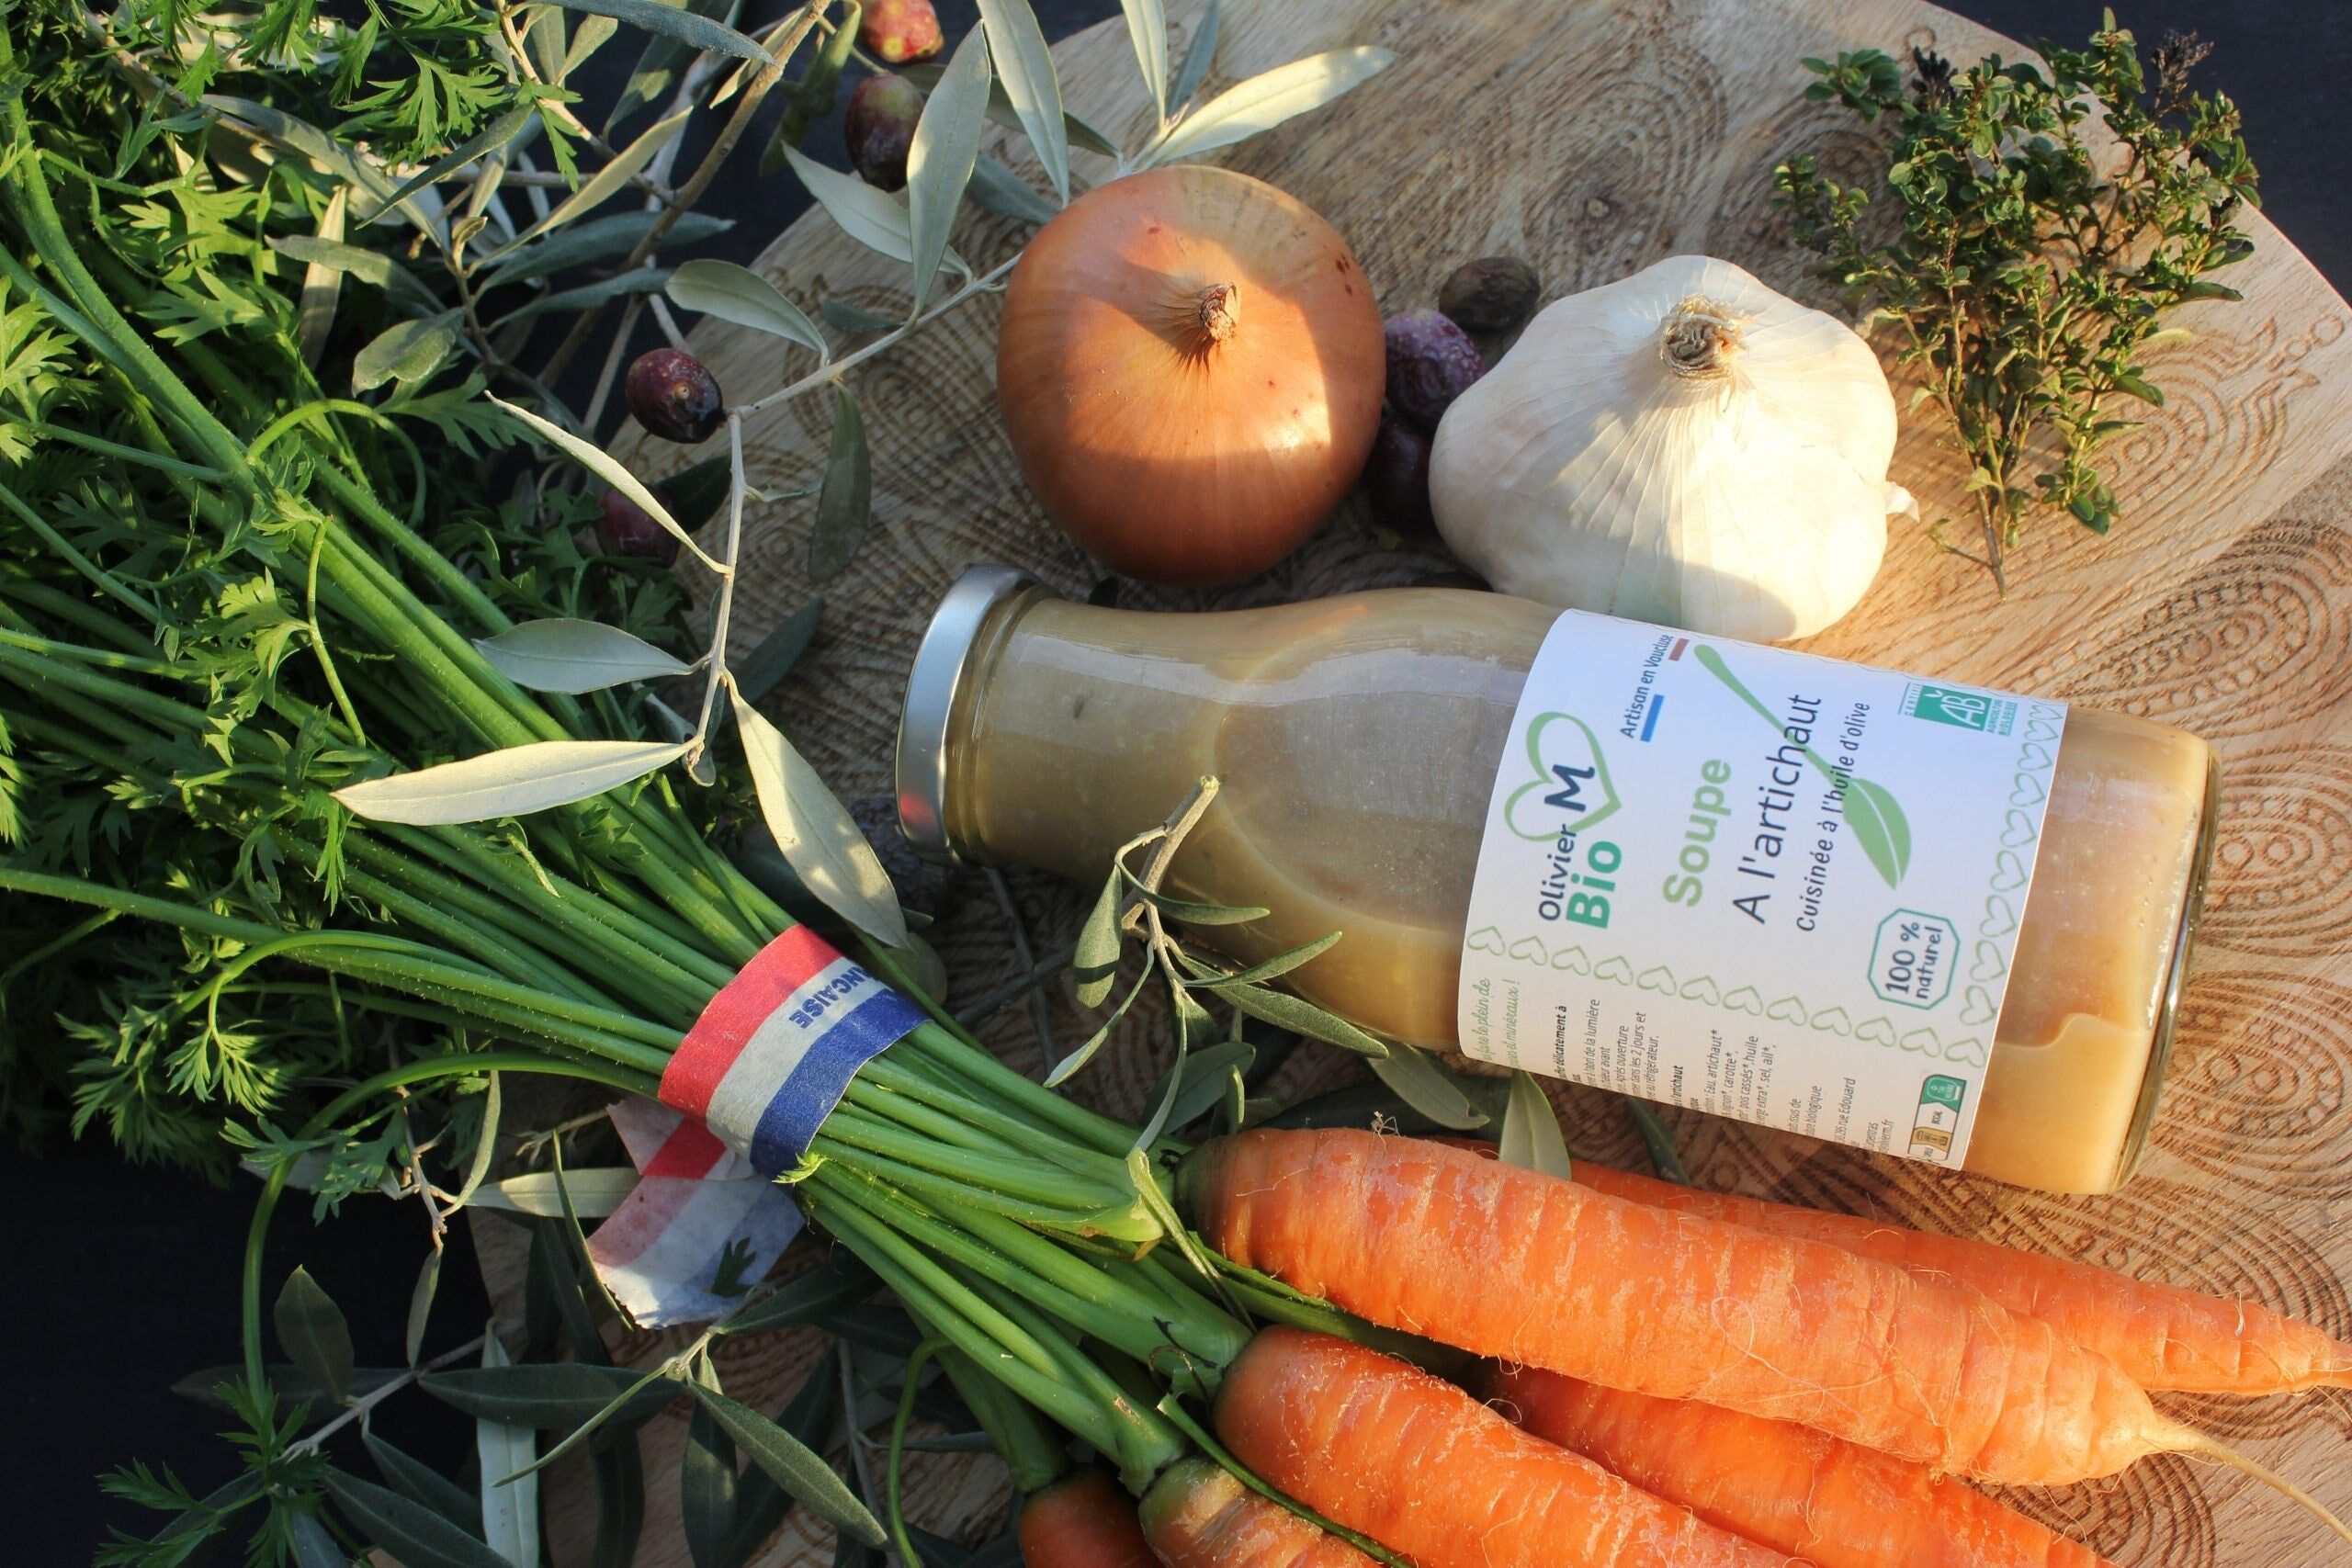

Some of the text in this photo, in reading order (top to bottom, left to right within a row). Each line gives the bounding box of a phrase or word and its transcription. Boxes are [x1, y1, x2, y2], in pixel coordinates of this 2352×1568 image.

[1620, 634, 1674, 739] Artisan en Vaucluse
[1940, 695, 1985, 727] AB
[1733, 694, 1822, 925] A l'artichaut
[1796, 702, 1871, 931] Cuisinée à l'huile d'olive
[1539, 764, 1595, 921] Olivier M
[1662, 759, 1732, 908] Soupe
[1566, 840, 1622, 930] Bio
[1885, 922, 1920, 994] 100 %
[1916, 926, 1943, 999] naturel
[1472, 977, 1492, 998] de
[1471, 997, 1494, 1028] plein
[1502, 987, 1520, 1039] minéraux
[1584, 999, 1600, 1035] lumière
[1635, 1011, 1646, 1022] et
[1583, 1047, 1596, 1057] de
[1616, 1026, 1629, 1066] ouverture
[1632, 1025, 1645, 1050] jours
[1629, 1056, 1642, 1067] les
[1789, 1098, 1802, 1109] de
[1804, 1086, 1823, 1123] biologique
[1838, 1077, 1856, 1114] Edouard
[1838, 1114, 1849, 1126] rue
